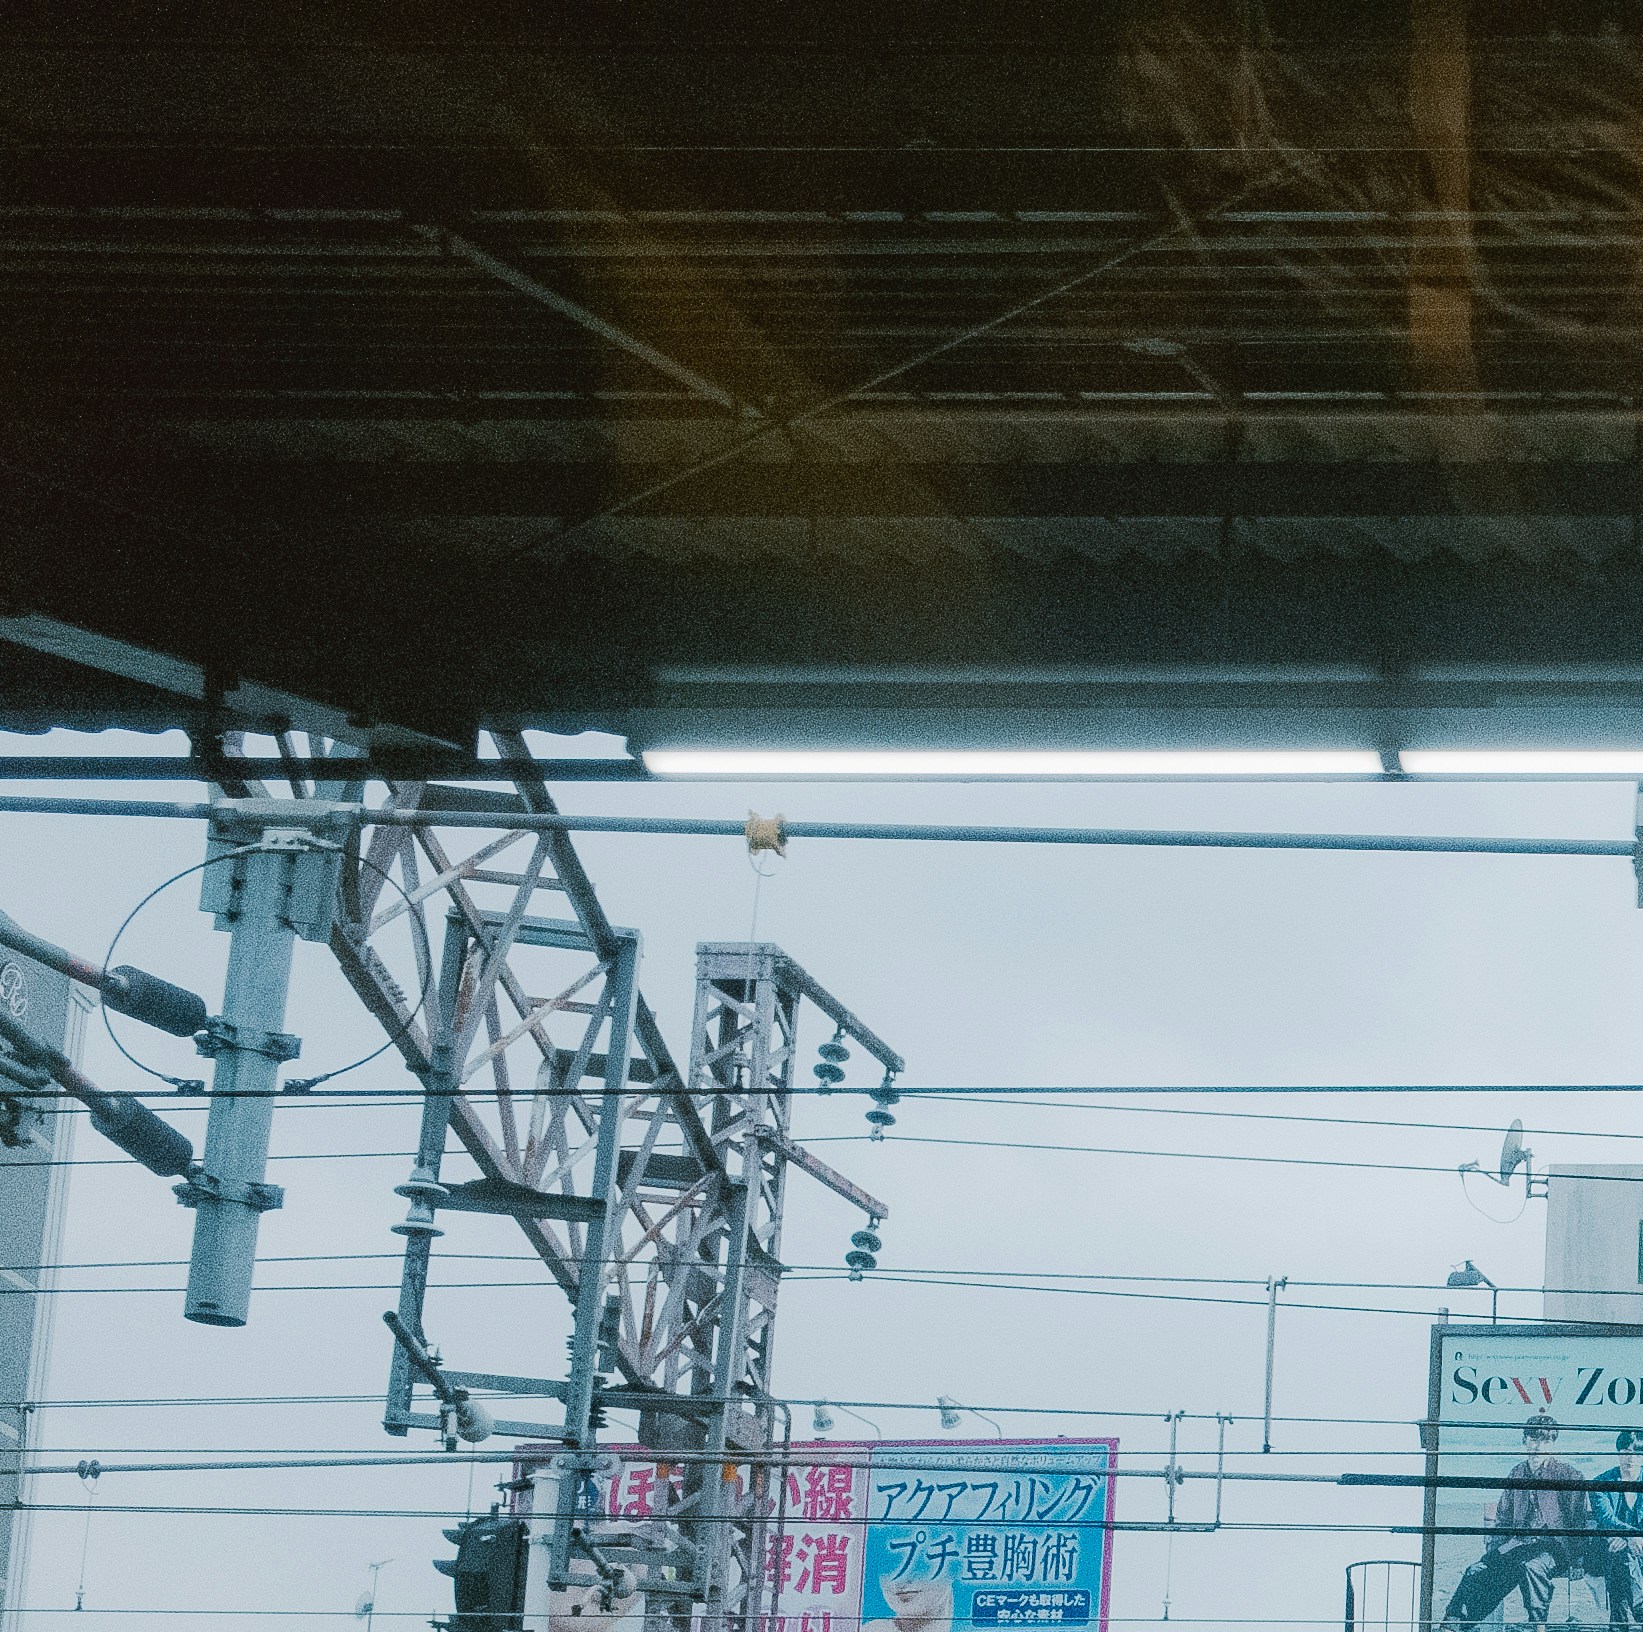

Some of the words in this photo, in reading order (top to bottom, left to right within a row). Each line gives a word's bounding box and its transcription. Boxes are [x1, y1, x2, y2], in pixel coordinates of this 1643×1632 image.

[1452, 1366, 1564, 1413] Sexy
[876, 1475, 1101, 1521] アクアフィリング
[889, 1530, 1080, 1582] プチ豊胸術
